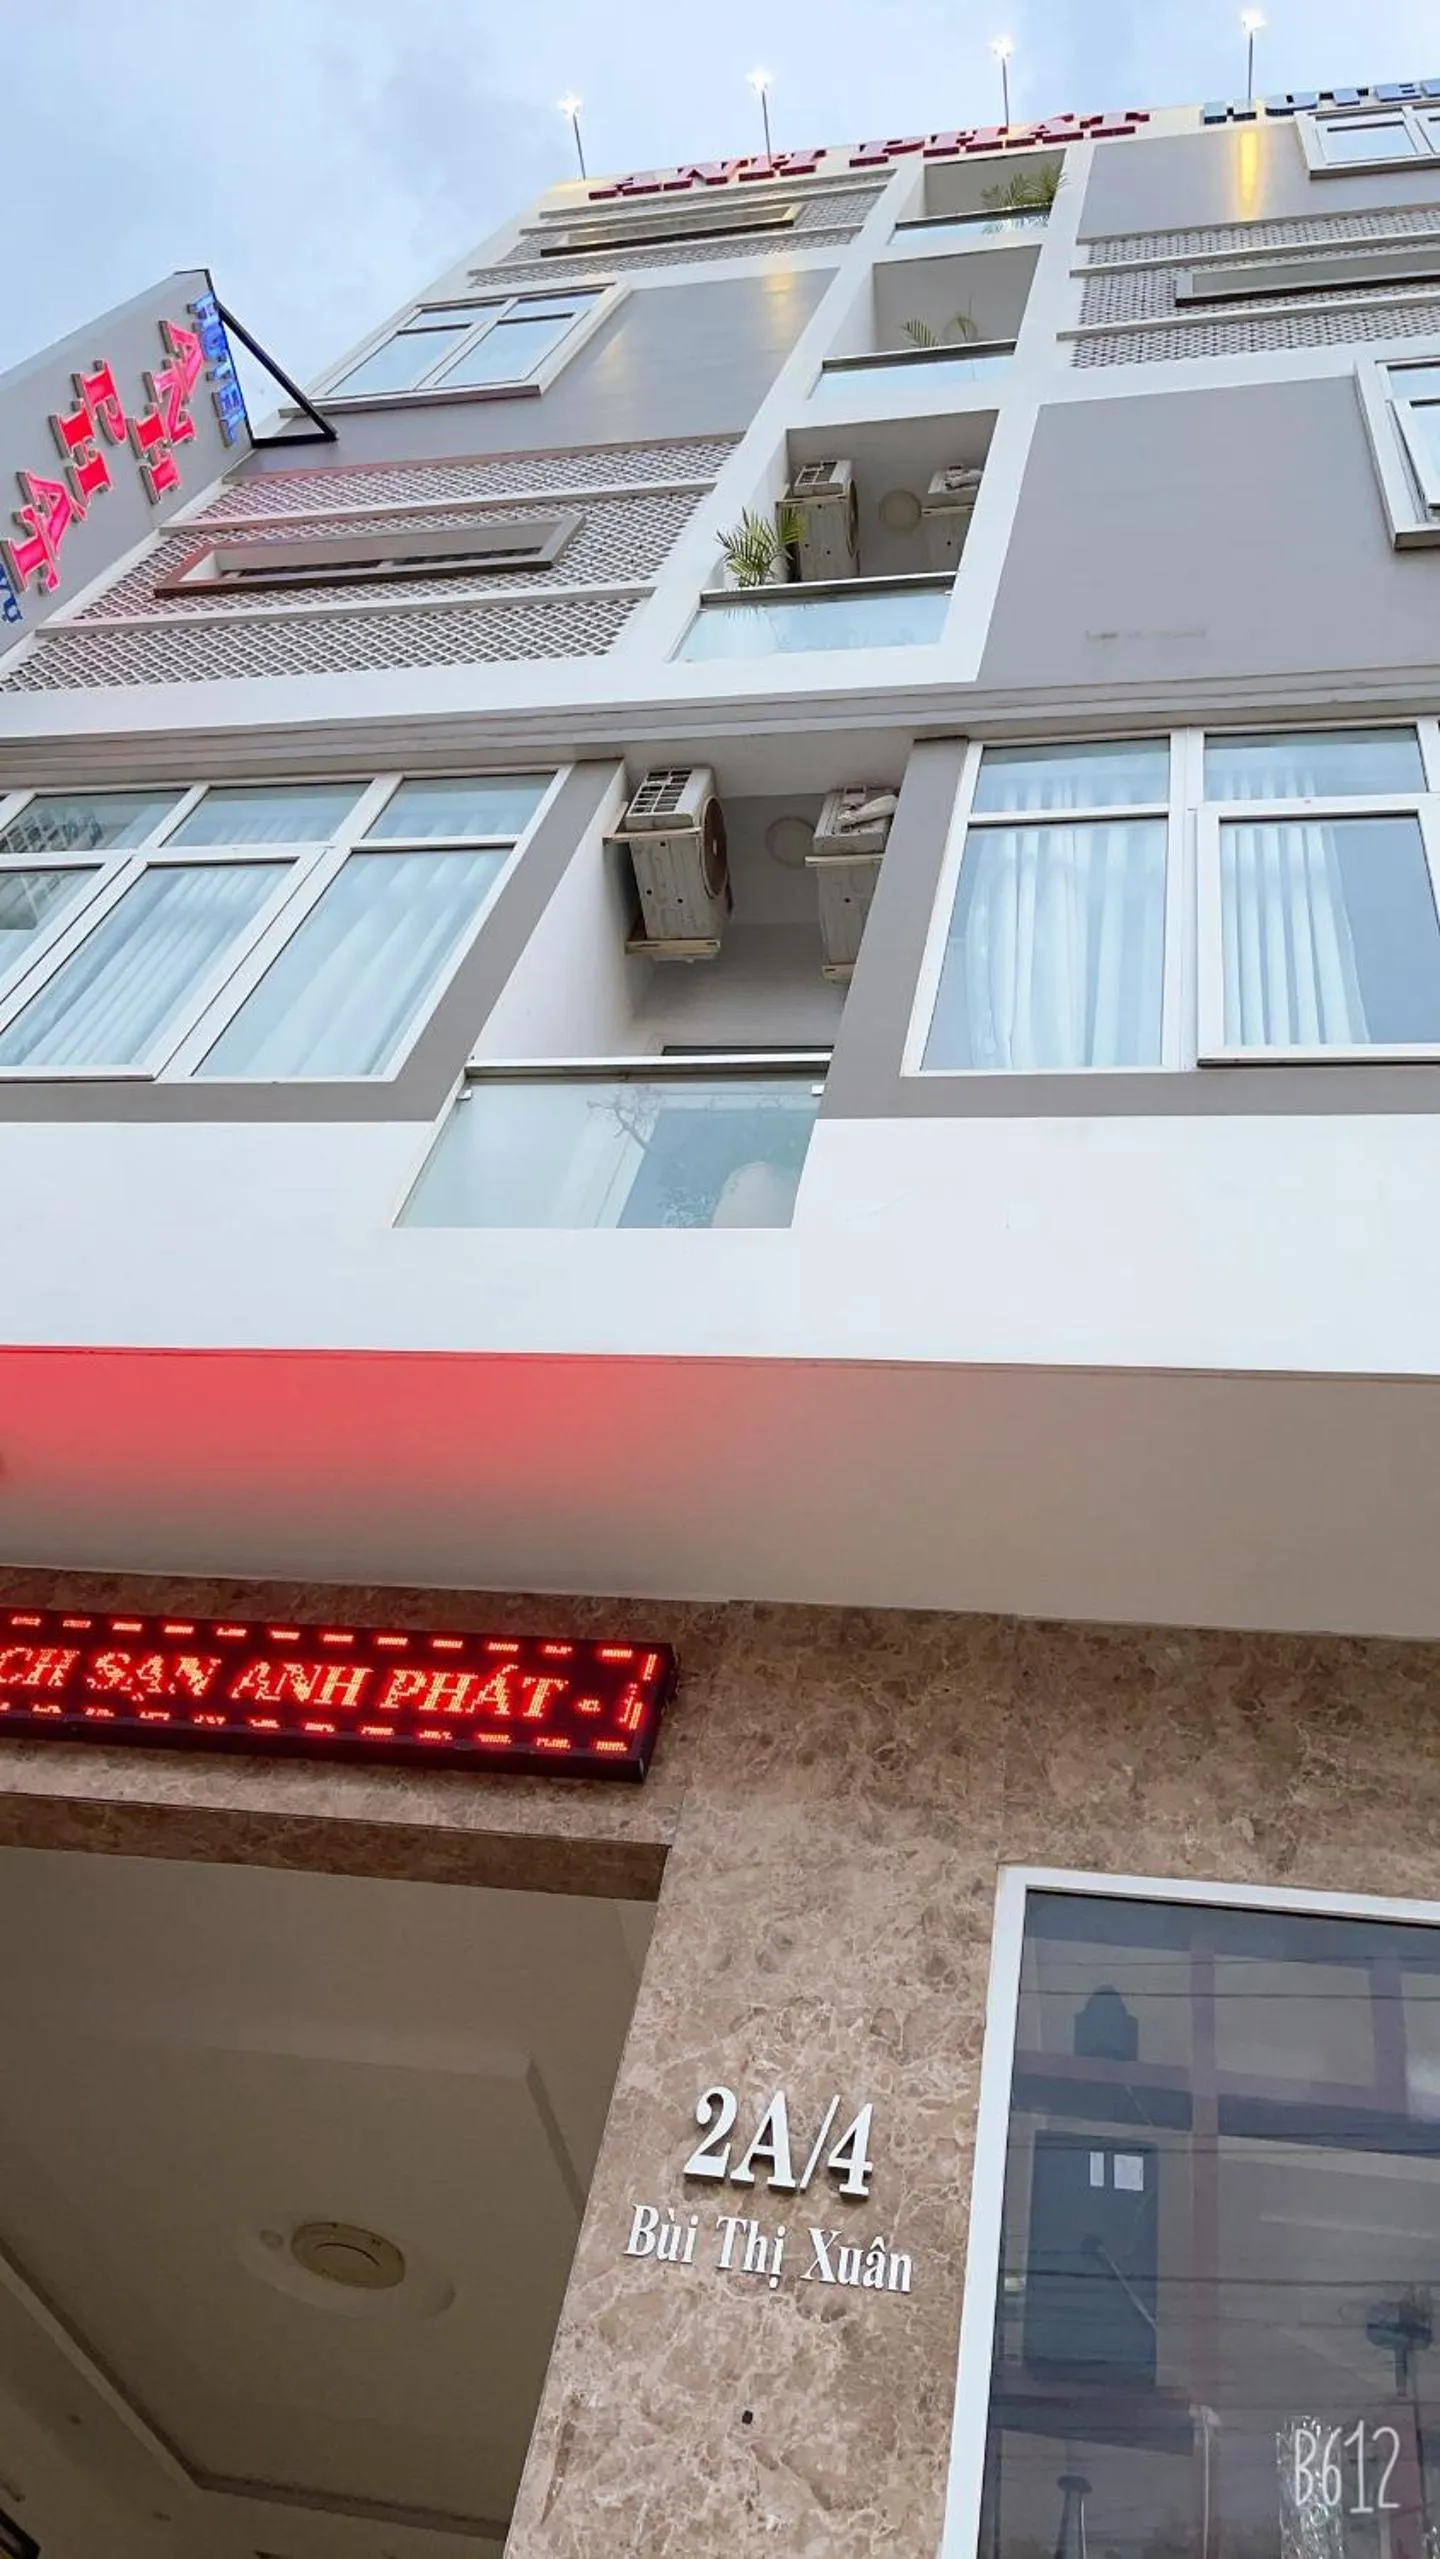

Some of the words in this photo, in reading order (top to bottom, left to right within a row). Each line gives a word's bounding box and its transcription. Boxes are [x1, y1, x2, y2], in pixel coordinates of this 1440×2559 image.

[588, 148, 828, 200] ANH
[128, 320, 205, 504] ANH
[191, 291, 247, 446] HOTEL
[2, 358, 127, 594] PHÁT
[231, 1661, 374, 1707] ANH
[380, 1663, 569, 1718] PHÁT
[683, 2085, 874, 2197] 2A/4
[623, 2203, 699, 2264] Bùi
[715, 2215, 786, 2290] Thị
[800, 2226, 914, 2293] Xuân
